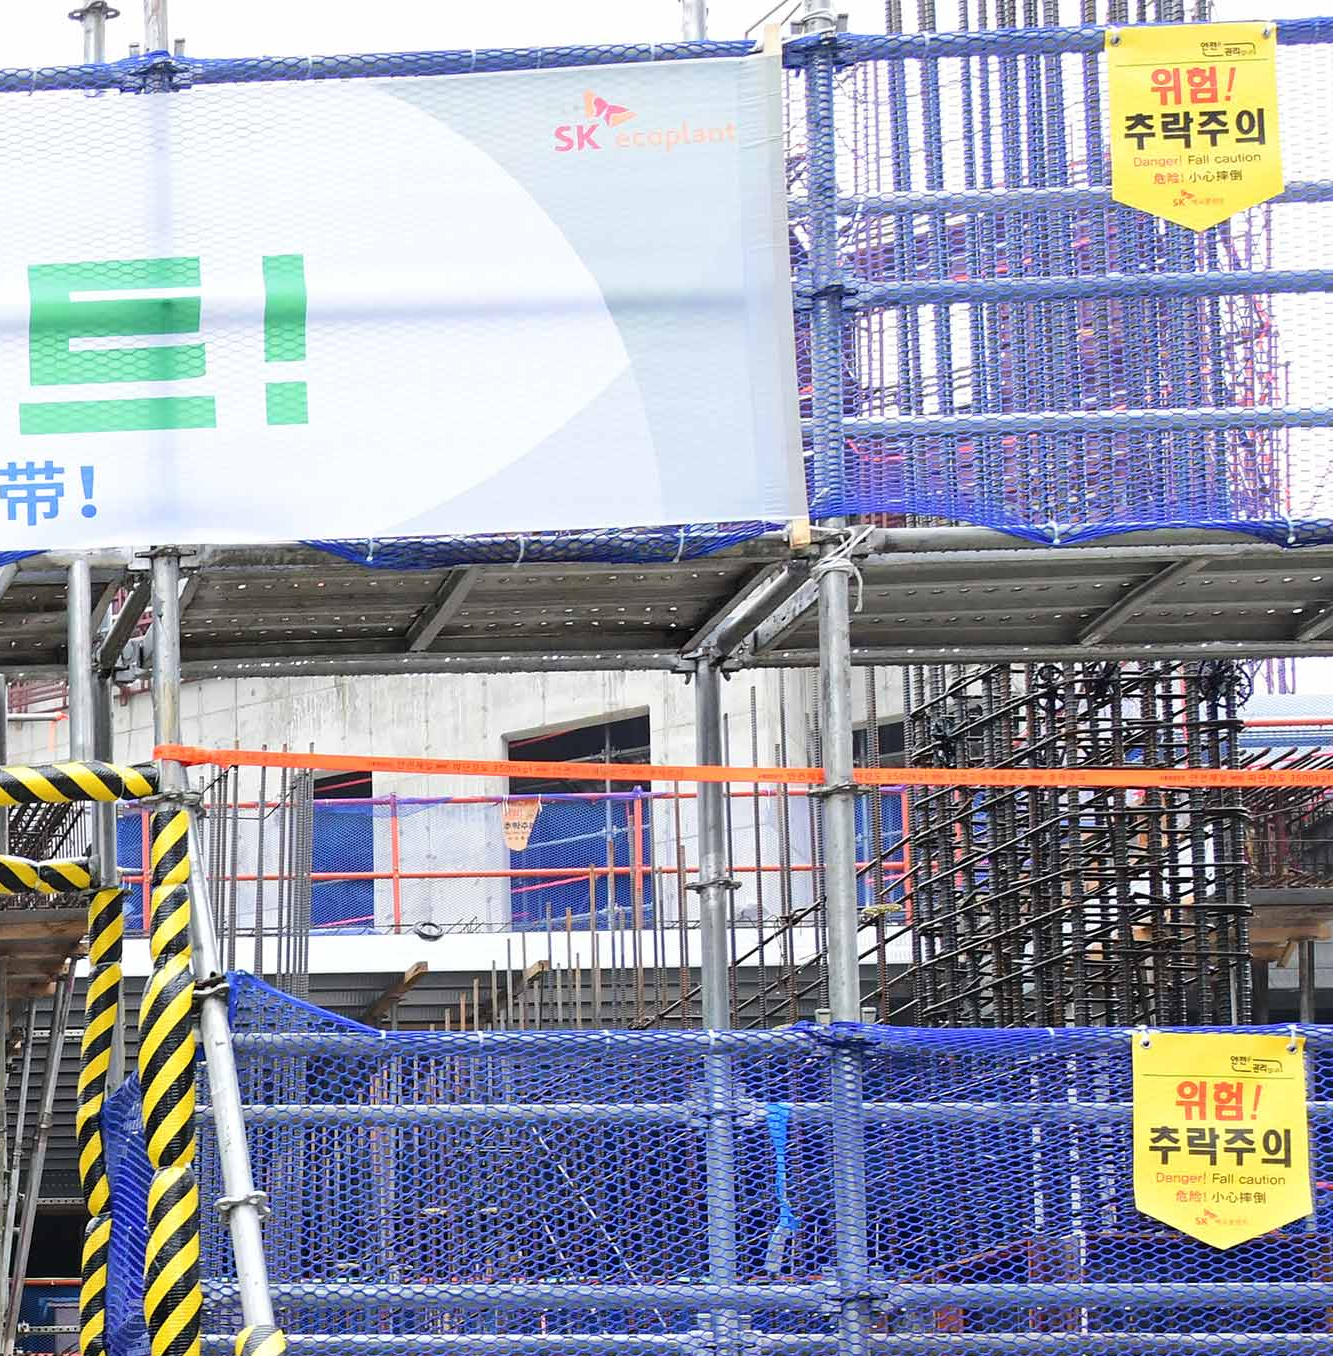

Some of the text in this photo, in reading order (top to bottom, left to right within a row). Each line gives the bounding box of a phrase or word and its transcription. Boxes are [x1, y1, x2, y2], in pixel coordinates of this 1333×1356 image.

[1150, 67, 1237, 106] 위험!
[554, 122, 736, 152] SK ecoplant
[1124, 107, 1266, 150] 추락주의
[1133, 152, 1261, 168] Danger! Fall caution
[1175, 1081, 1263, 1121] 위험!
[1148, 1126, 1292, 1168] 추락주의
[1156, 1172, 1286, 1185] Danger! Fall caution
